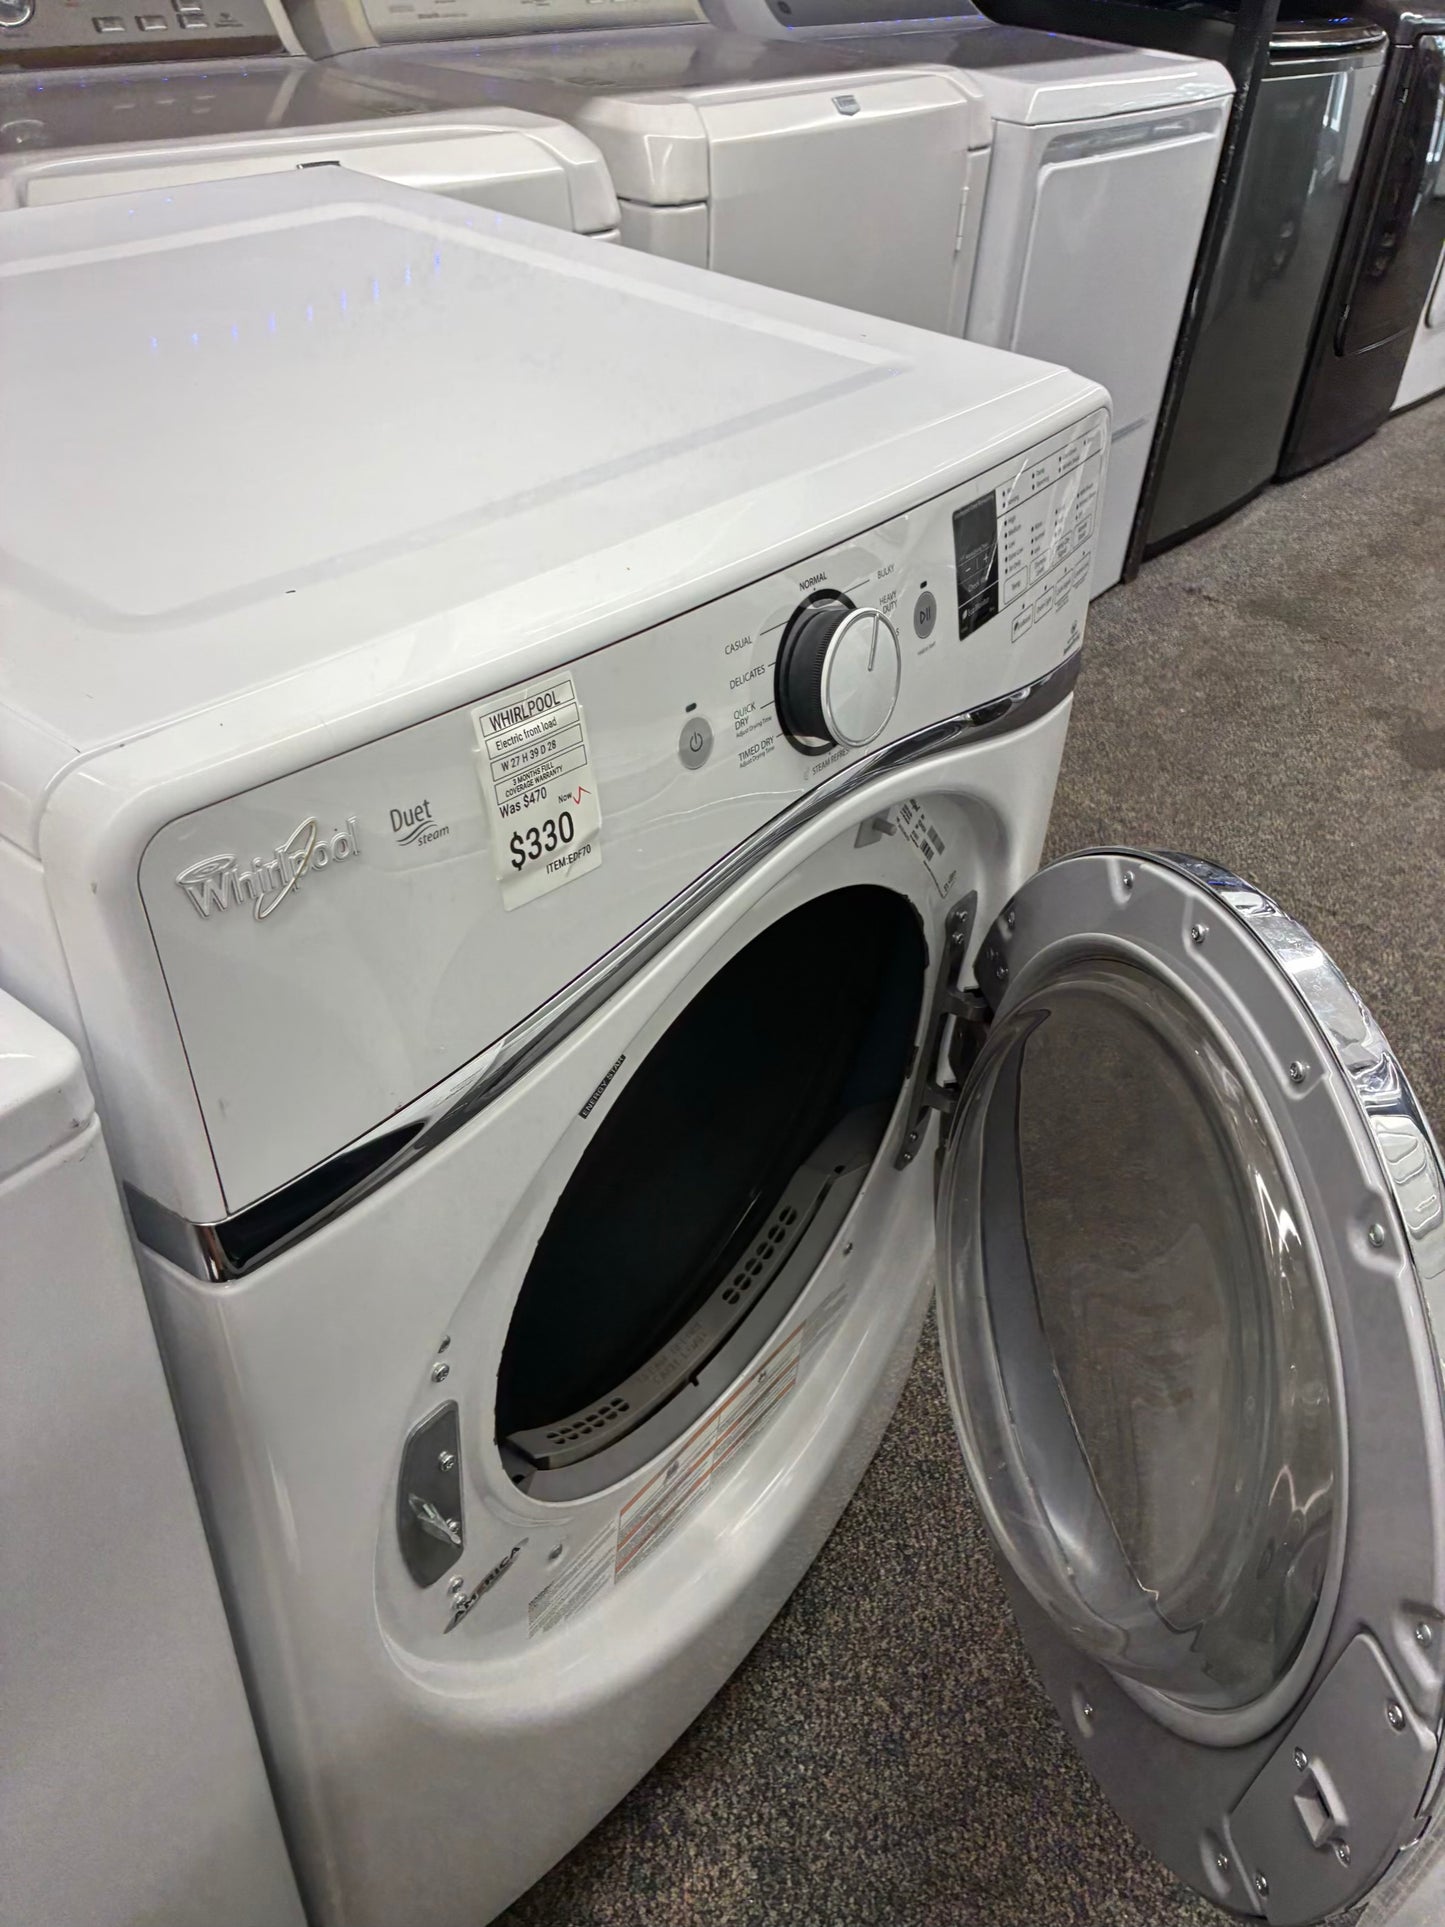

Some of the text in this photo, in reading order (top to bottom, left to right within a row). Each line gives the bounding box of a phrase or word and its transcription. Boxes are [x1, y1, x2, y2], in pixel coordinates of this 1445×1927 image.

[799, 571, 827, 591] NORMAL
[877, 563, 894, 579] BULKY
[879, 590, 897, 605] HEAVY
[882, 600, 897, 613] DUTY
[724, 635, 753, 655] CASUAL
[730, 664, 766, 690] DELICATES
[489, 691, 561, 731] WHIRLPOOL
[734, 701, 756, 719] QUICK
[735, 716, 749, 730] DRY
[496, 717, 557, 751] Electric front load
[501, 740, 557, 772] W 27 H 39 D 28
[738, 736, 774, 761] TIMED DRY
[812, 748, 850, 775] STEAM REFRES
[505, 765, 563, 797] COVERAGE WARRANTY
[516, 767, 540, 784] MONTHS
[540, 762, 554, 775] FULL
[500, 787, 547, 819] Was $470
[558, 791, 572, 804] Now
[390, 798, 433, 833] Duet
[417, 823, 450, 846] steam
[510, 811, 574, 871] $330
[179, 815, 362, 921] Whirlpool
[546, 844, 592, 875] ITEM:EDF70
[582, 1080, 608, 1116] ENERGY
[454, 1547, 520, 1623] AMERICA
